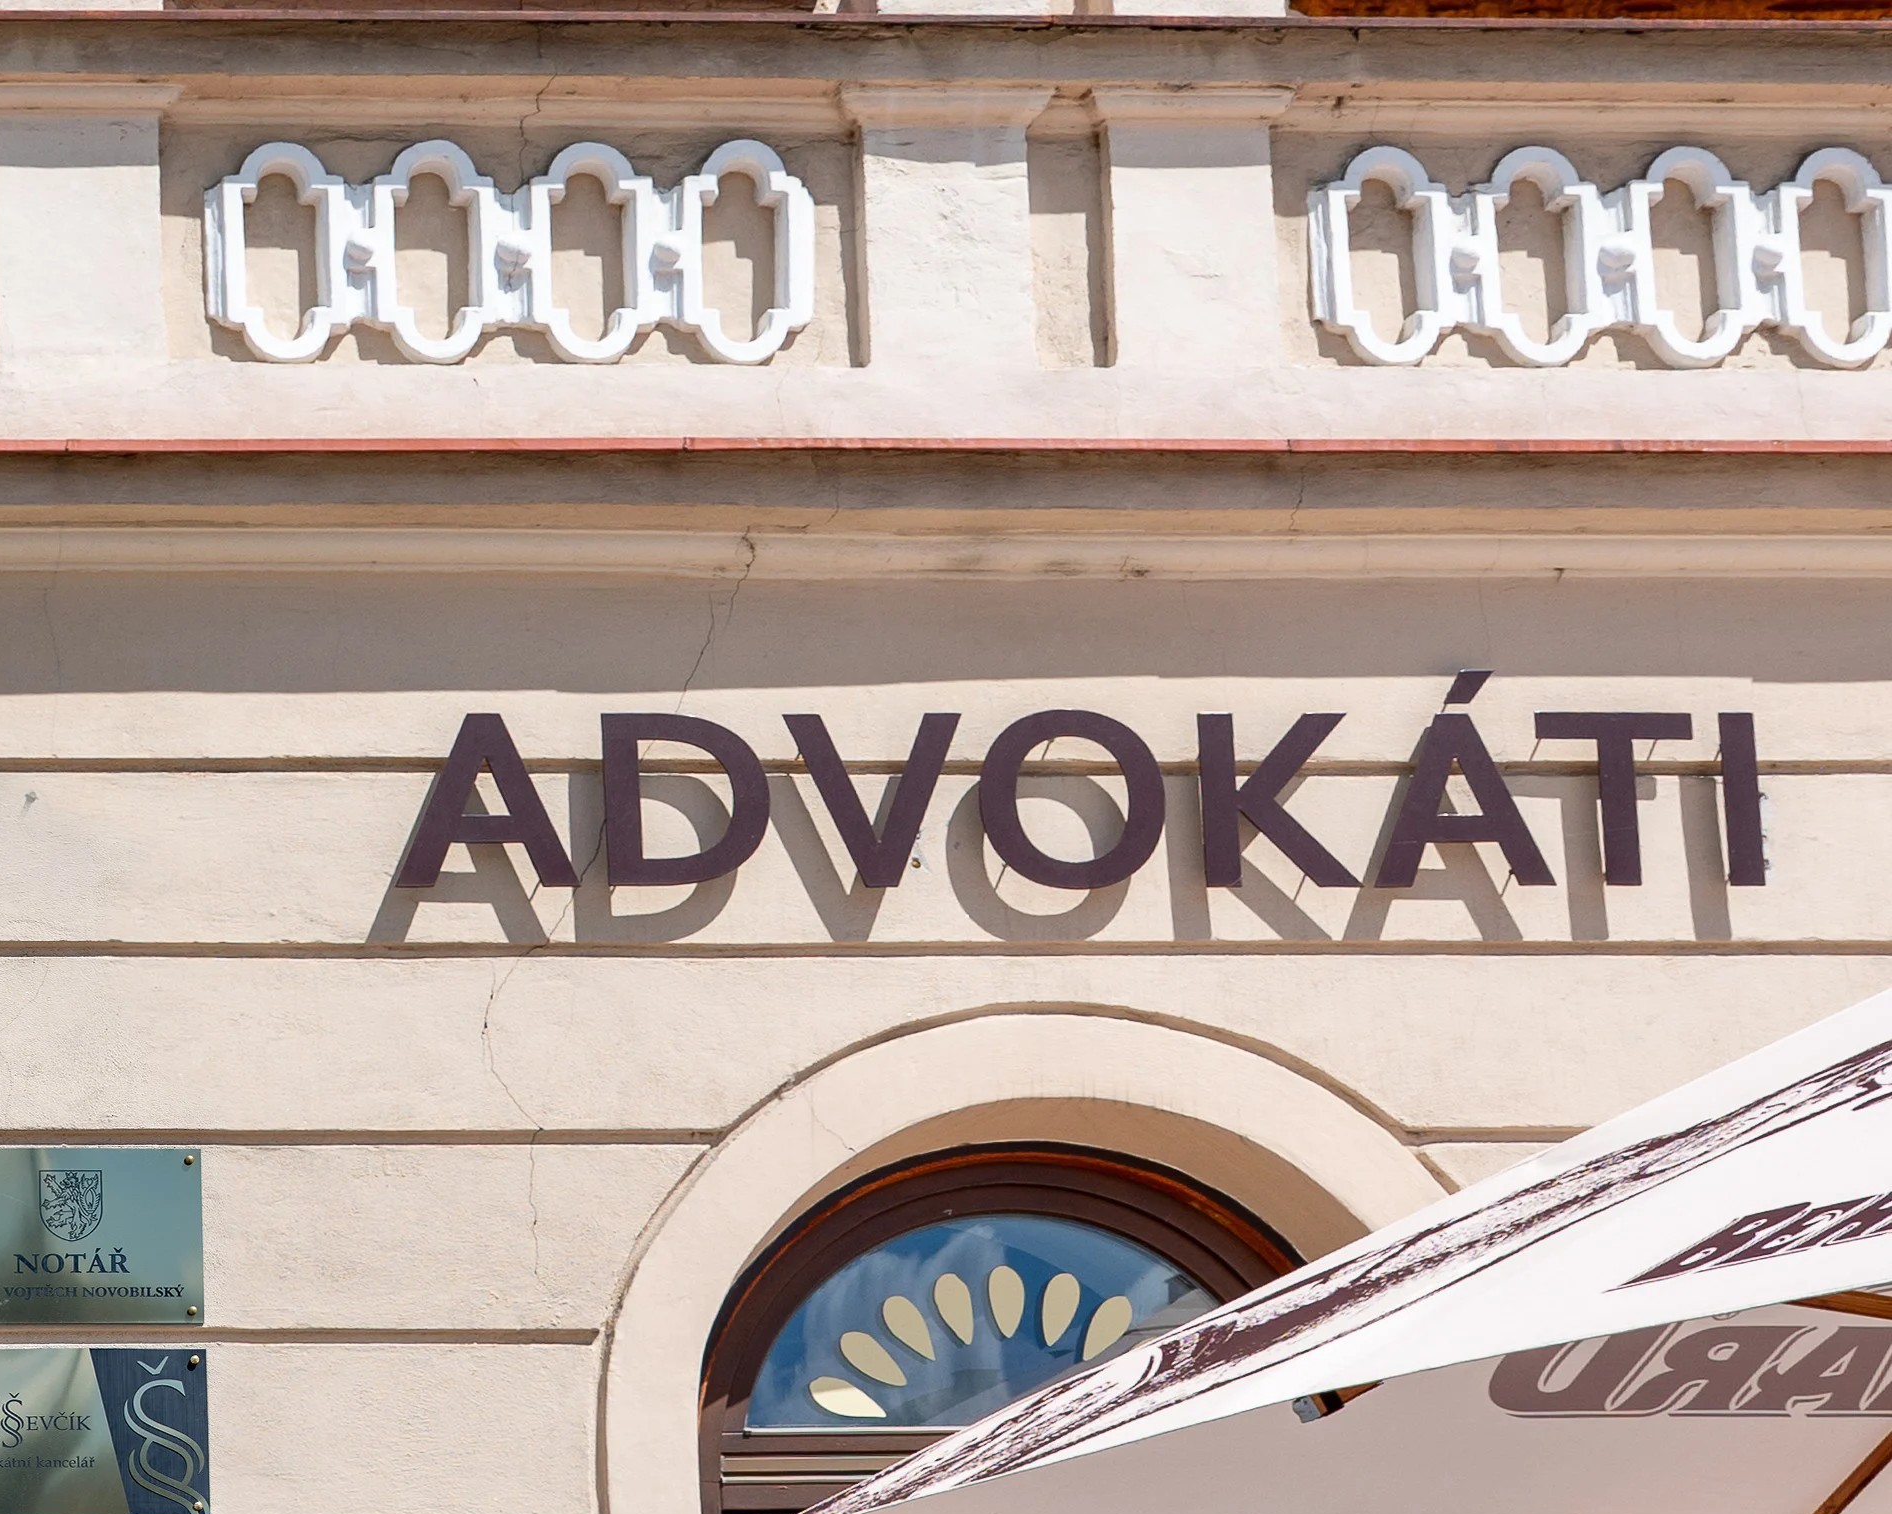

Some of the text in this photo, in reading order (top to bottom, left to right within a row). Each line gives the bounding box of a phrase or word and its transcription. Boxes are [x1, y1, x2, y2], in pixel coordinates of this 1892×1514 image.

[395, 669, 1767, 889] ADVOKÁTI
[13, 1247, 130, 1274] NOTÁŘ
[3, 1283, 78, 1300] VOJTĚCH
[82, 1283, 184, 1299] NOVOBILSKÝ
[36, 1455, 96, 1469] kancelář
